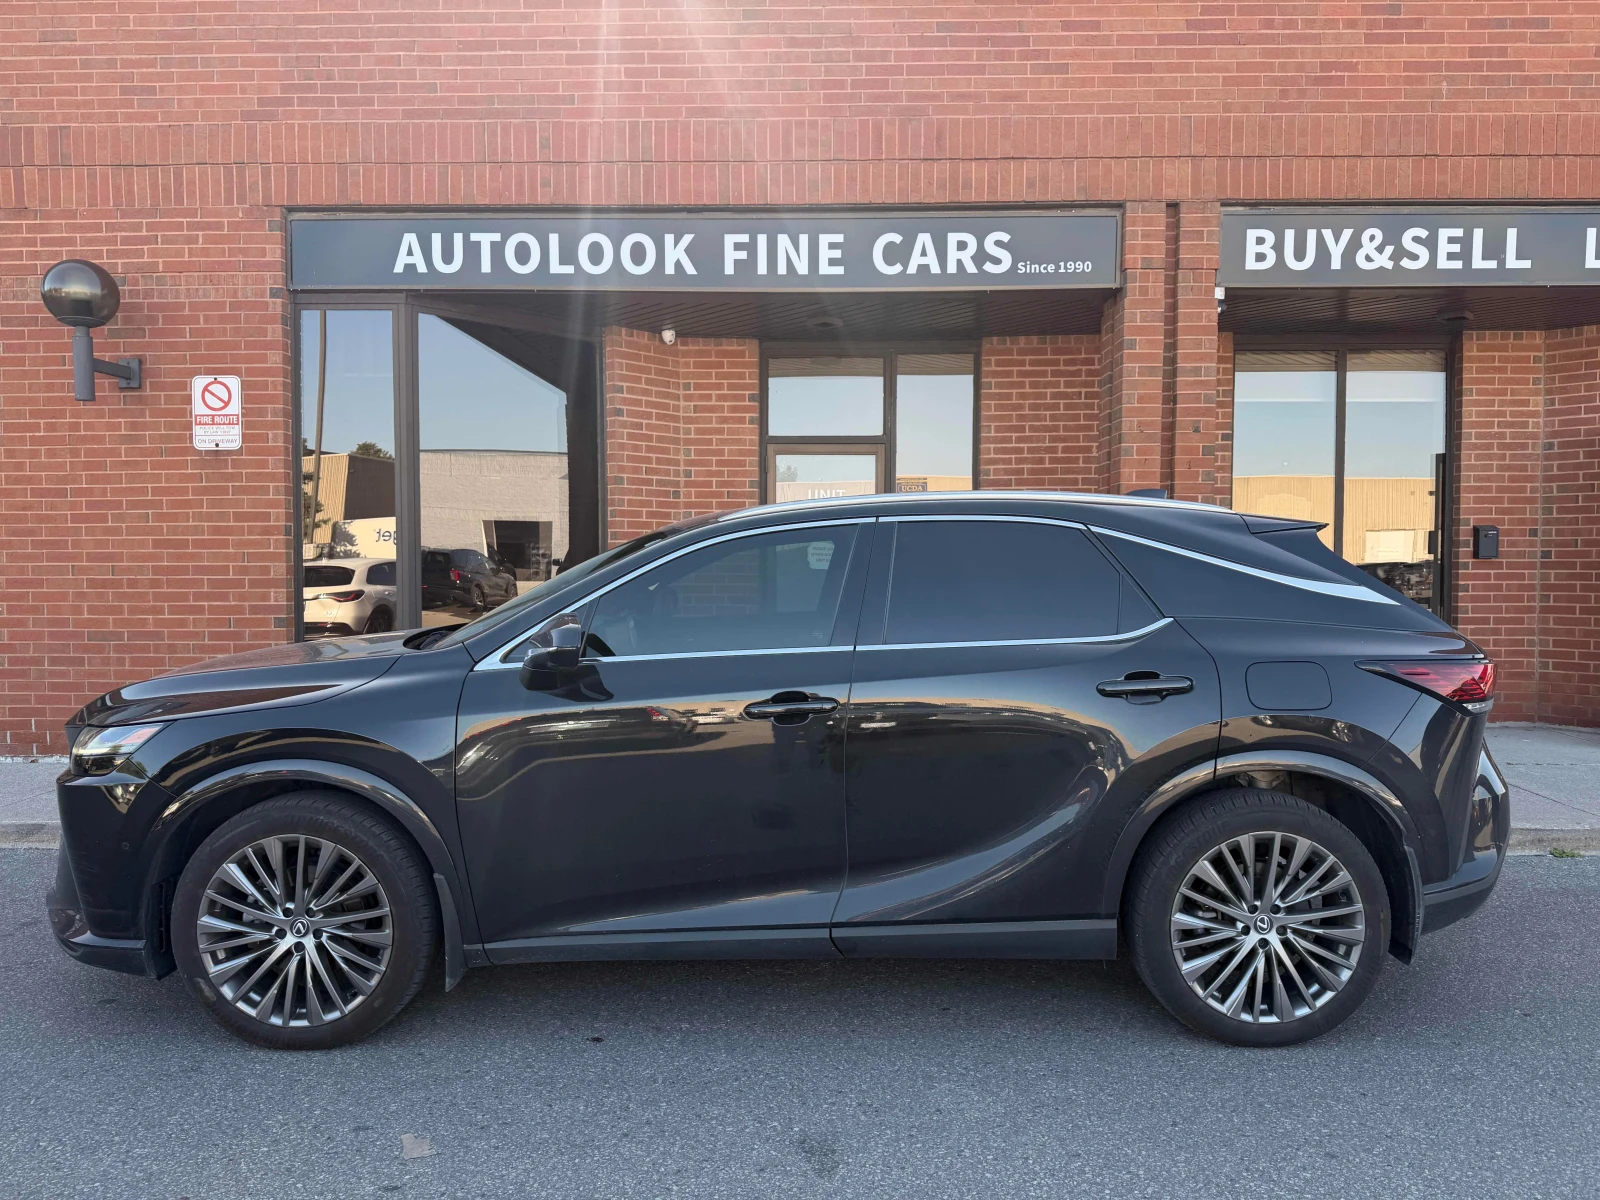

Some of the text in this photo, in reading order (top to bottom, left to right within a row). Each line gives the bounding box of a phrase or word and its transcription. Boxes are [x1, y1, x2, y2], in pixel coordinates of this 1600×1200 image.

[393, 231, 1013, 276] AUTOLOOK FINE CARS
[1245, 227, 1532, 271] BUY&SELL
[1017, 261, 1092, 274] Since 1990
[196, 415, 238, 424] FIRE ROUTE
[808, 489, 846, 499] UNIT
